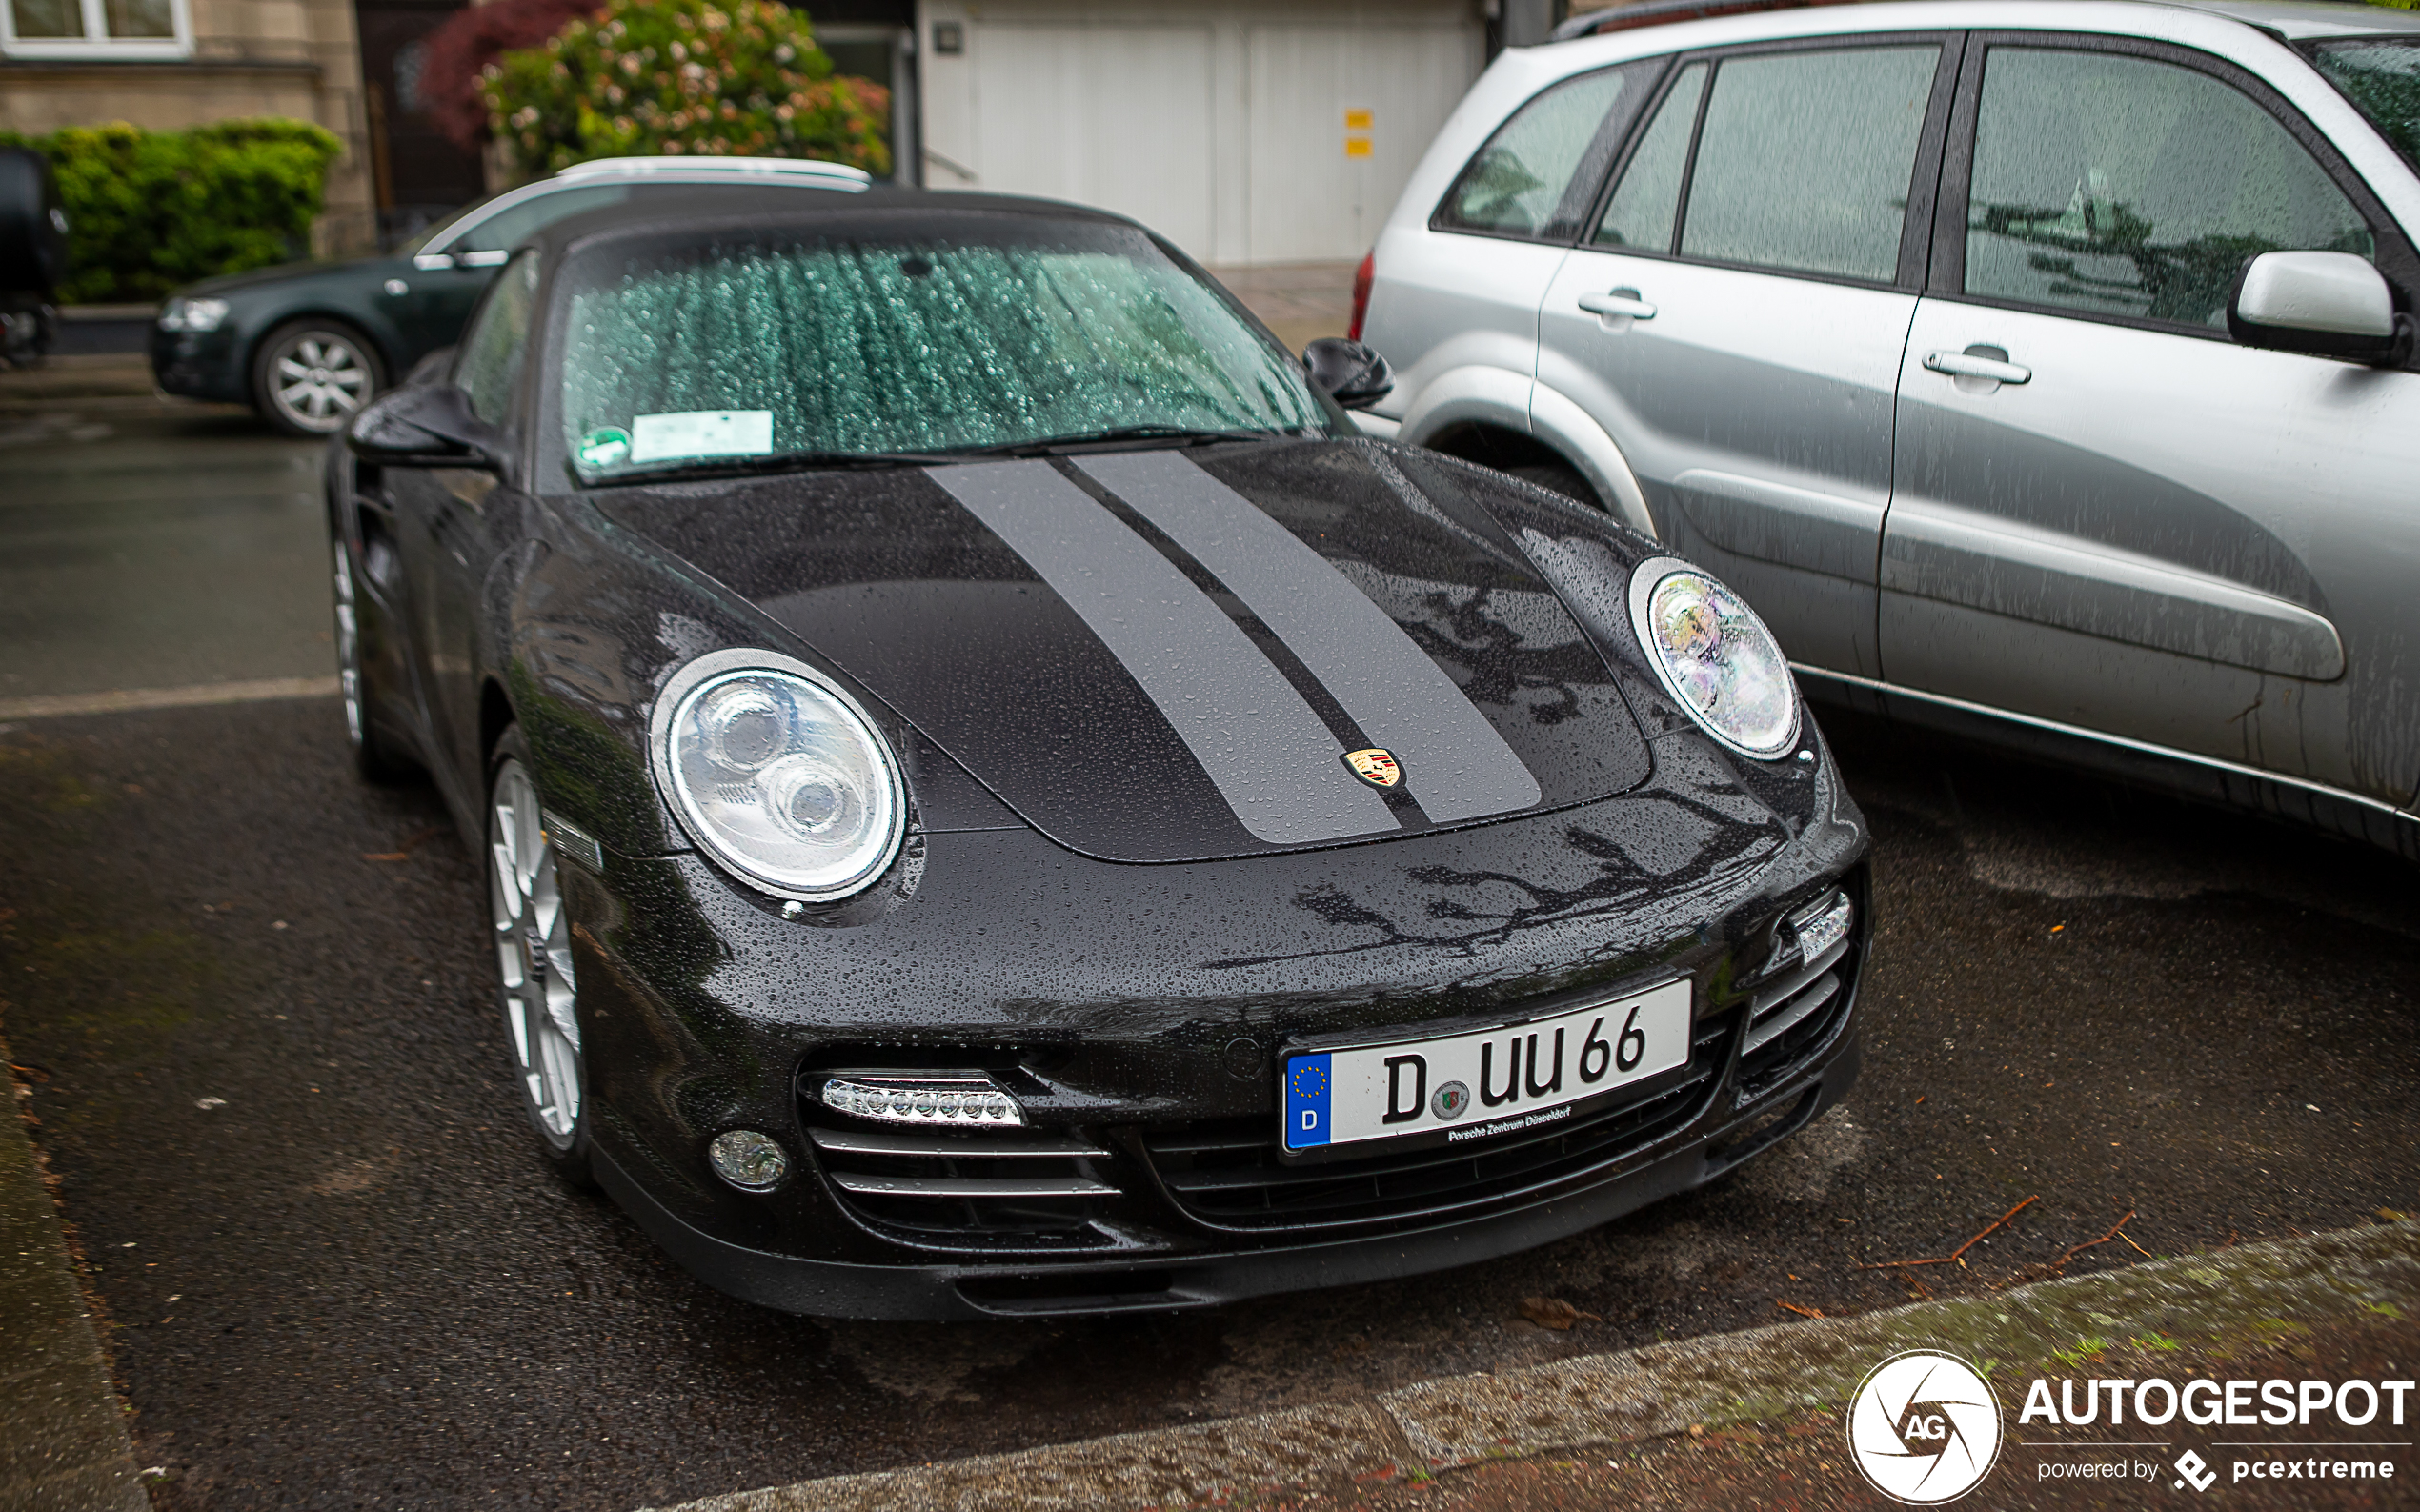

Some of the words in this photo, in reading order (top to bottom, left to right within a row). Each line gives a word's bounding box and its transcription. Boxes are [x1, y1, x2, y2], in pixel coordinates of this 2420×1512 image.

[1381, 1054, 1427, 1125] D
[1480, 1026, 1565, 1108] UU
[1579, 1005, 1646, 1084] 66
[1301, 1110, 1318, 1131] D
[1448, 1126, 1486, 1141] Porsche
[1486, 1119, 1524, 1135] Zentrum
[1525, 1105, 1571, 1126] Düsseldorf
